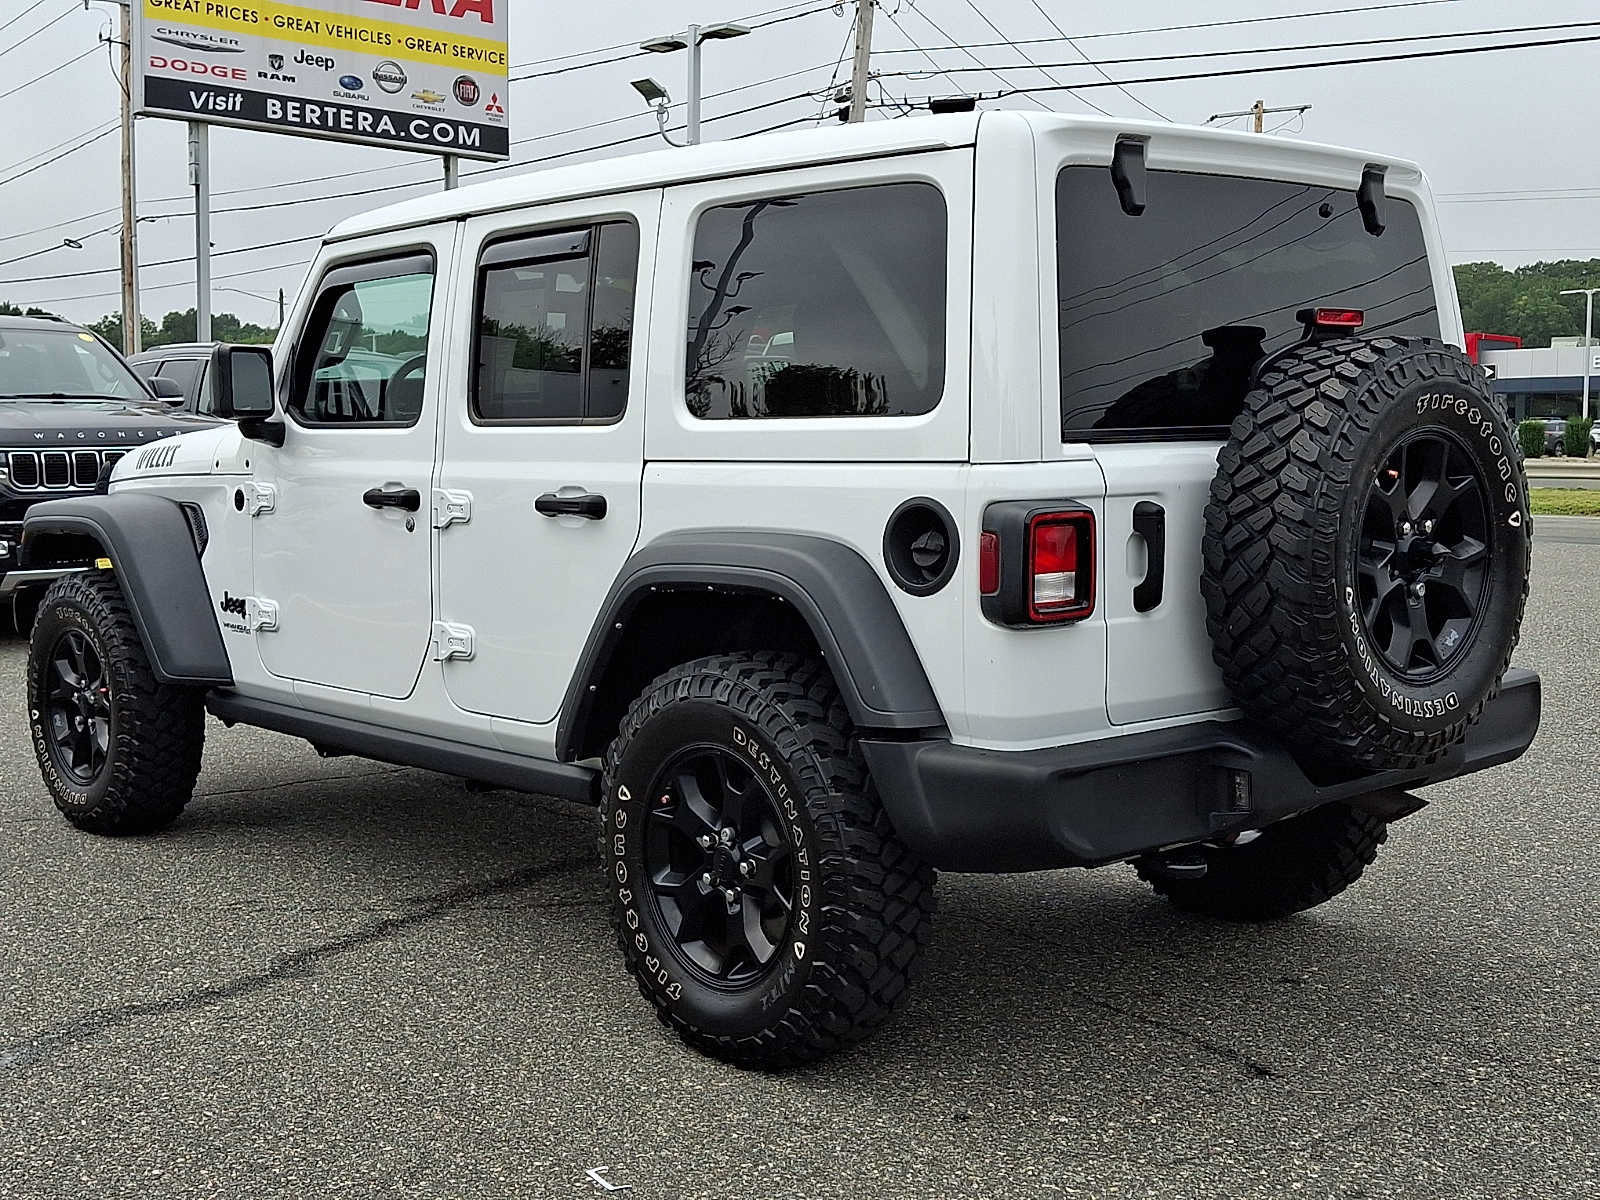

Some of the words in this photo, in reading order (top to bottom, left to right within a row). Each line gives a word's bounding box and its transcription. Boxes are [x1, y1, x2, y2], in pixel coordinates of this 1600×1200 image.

[156, 27, 240, 46] CHRYSLER
[206, 3, 259, 24] PRICES
[273, 14, 321, 34] GREAT
[325, 23, 392, 46] VEHICLES
[405, 37, 448, 55] GREAT
[452, 44, 506, 65] SERVICE
[150, 56, 248, 81] DODGE
[293, 49, 335, 71] Jeep
[257, 71, 296, 83] RAM
[375, 72, 404, 83] NISSAN
[332, 90, 370, 101] SUBARU
[459, 83, 475, 100] FIAT
[189, 90, 244, 112] Visit
[266, 98, 481, 147] BERTERA.COM
[135, 444, 182, 471] WILLYS
[1416, 393, 1517, 503] Firestone
[220, 591, 247, 620] Jeep
[1349, 613, 1460, 718] DESTINATION
[733, 726, 812, 935] DESTINATION
[613, 808, 682, 1002] Firestone
